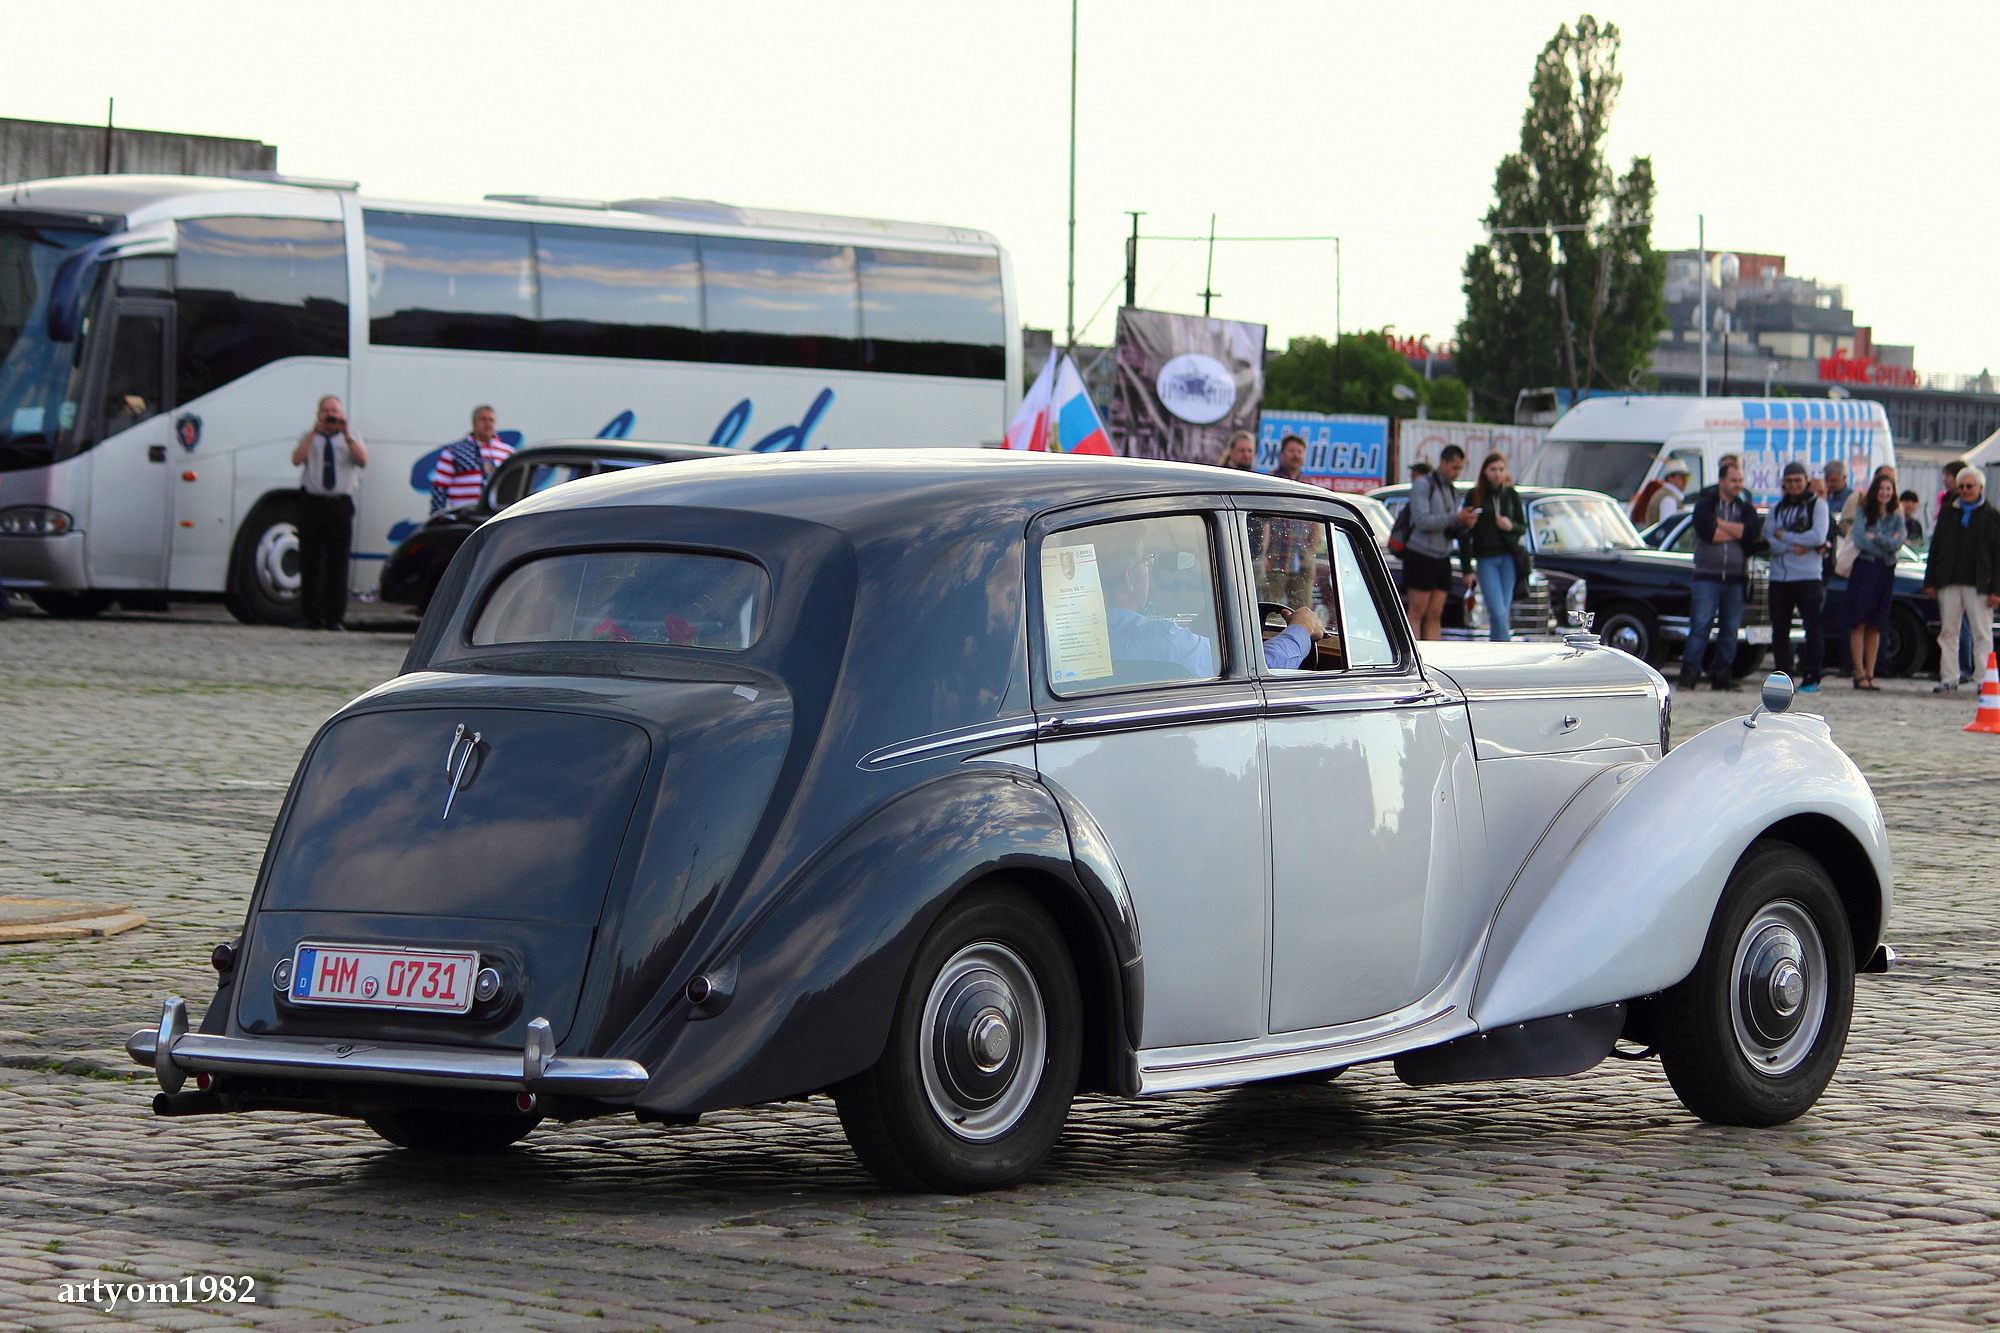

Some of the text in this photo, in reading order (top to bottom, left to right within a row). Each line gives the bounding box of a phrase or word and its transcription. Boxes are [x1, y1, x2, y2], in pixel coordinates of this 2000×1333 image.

[1539, 529, 1558, 545] 21
[318, 956, 457, 1000] HM 0731
